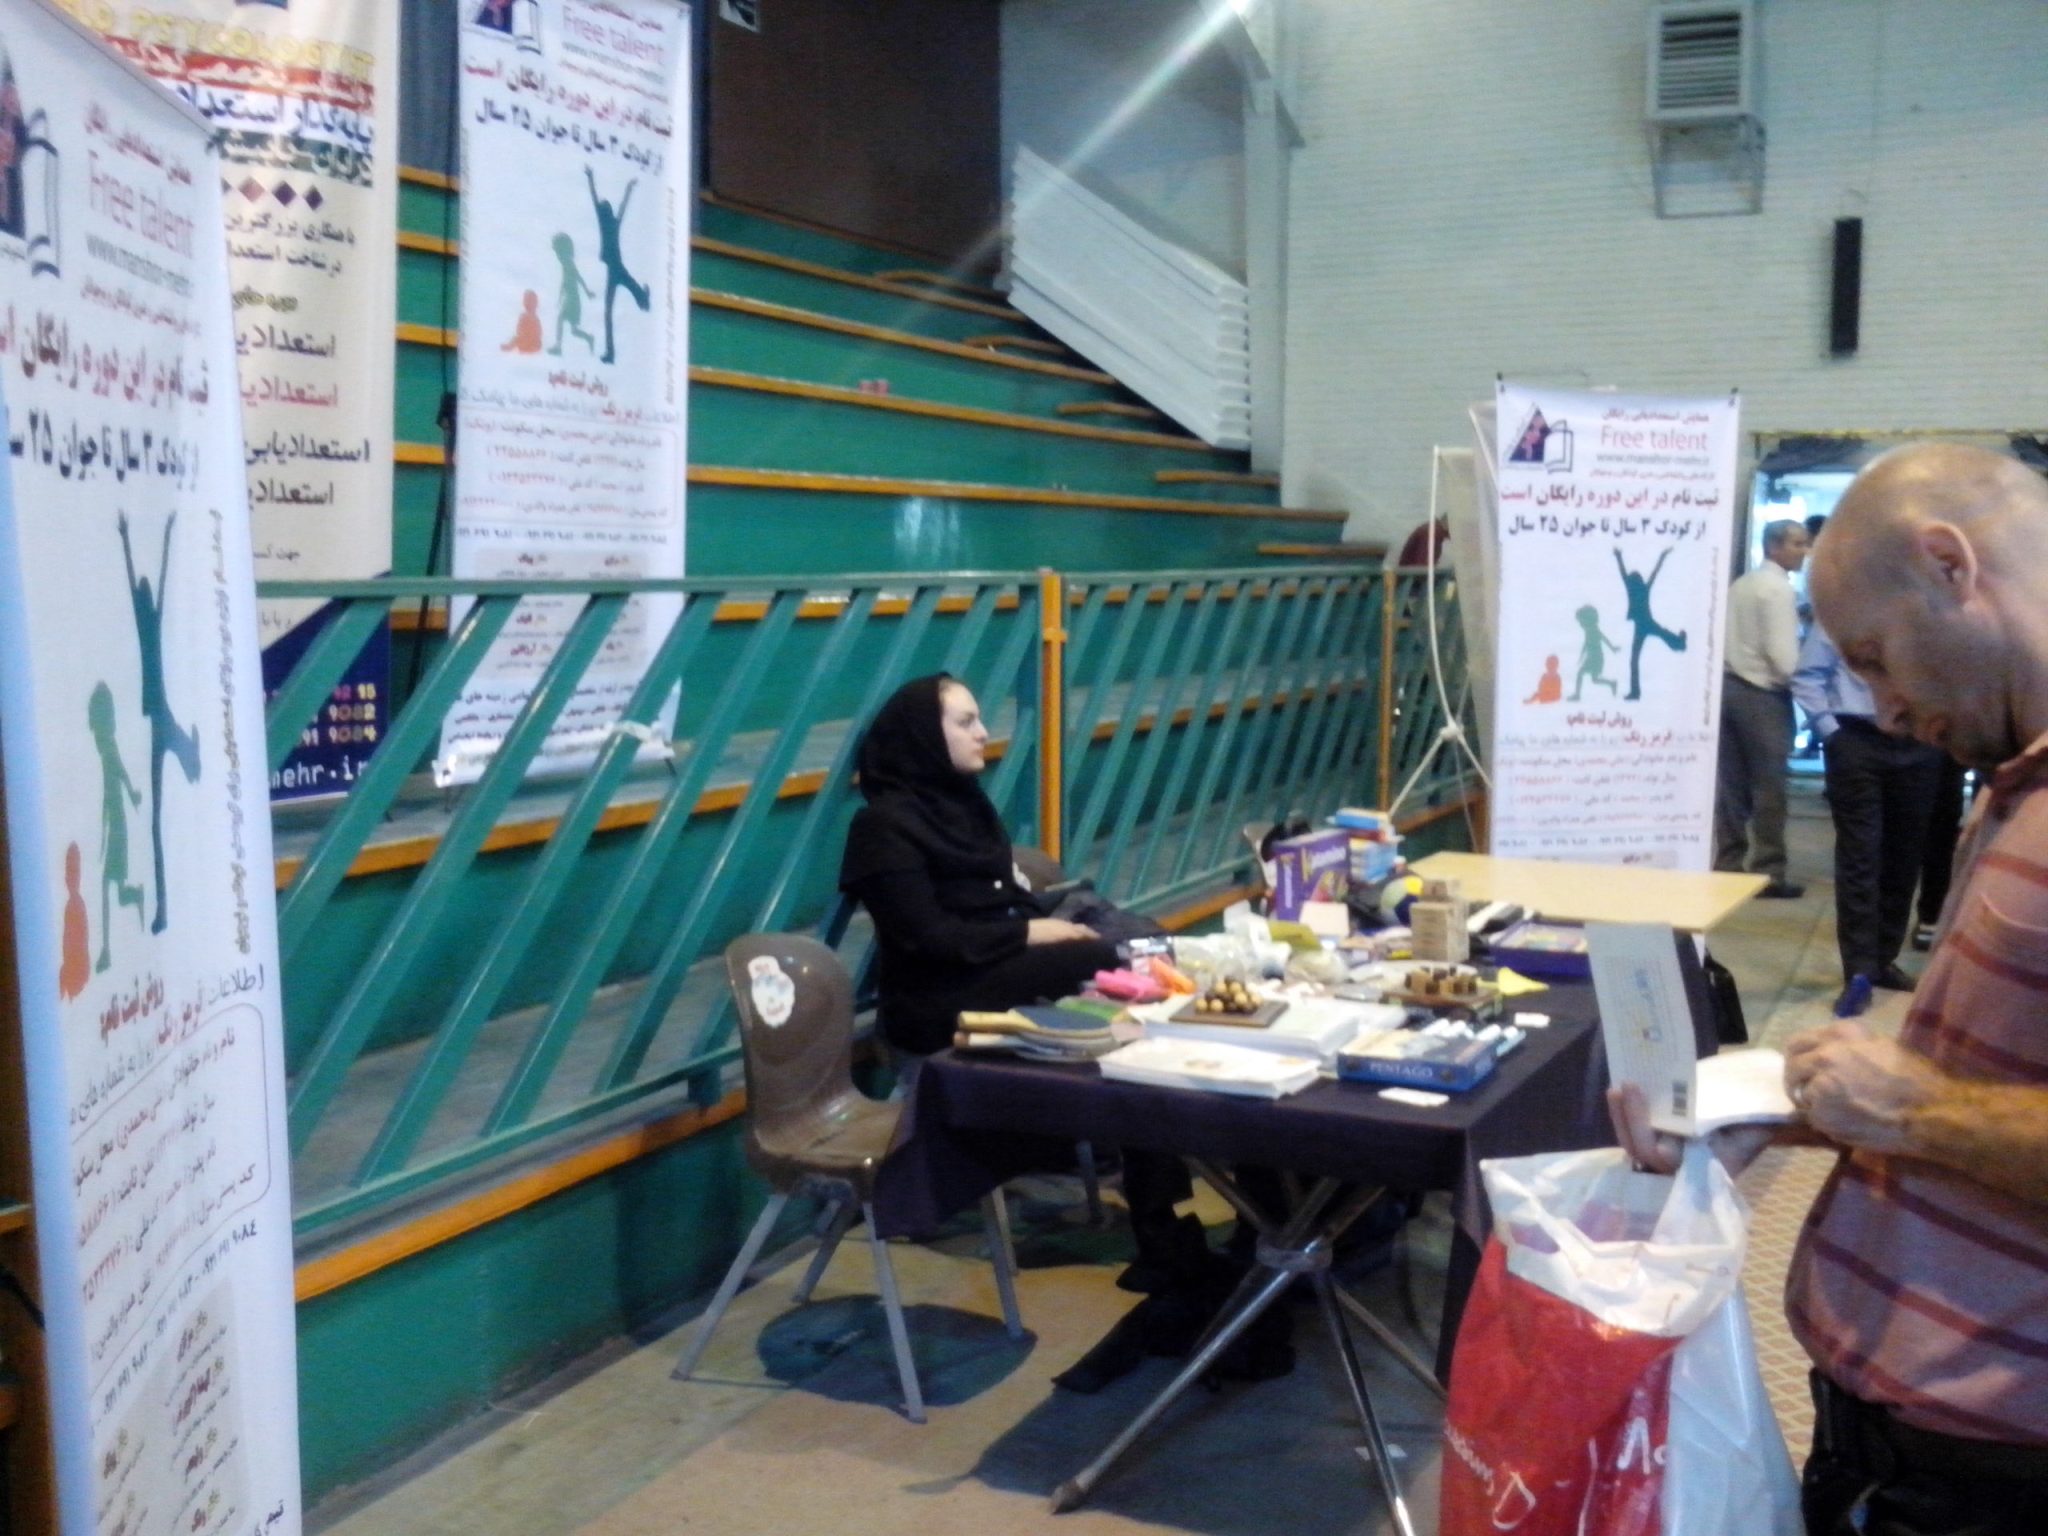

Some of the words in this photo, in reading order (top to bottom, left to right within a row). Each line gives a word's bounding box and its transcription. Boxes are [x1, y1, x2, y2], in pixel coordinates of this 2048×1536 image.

[1600, 424, 1644, 449] Free
[1649, 427, 1708, 450] talent
[1500, 485, 1533, 501] است
[1536, 484, 1584, 506] رایگان
[1587, 488, 1622, 508] دوره
[1625, 487, 1649, 508] این
[1652, 491, 1669, 510] در
[1672, 487, 1692, 507] نام
[1693, 488, 1719, 510] ثبت
[1508, 515, 1535, 535] سال
[1563, 519, 1597, 537] جوان
[1600, 518, 1610, 533] تا
[1613, 519, 1637, 537] سال
[1655, 519, 1692, 539] کودک
[1693, 521, 1707, 540] از
[1370, 1061, 1434, 1078] PENTAGO
